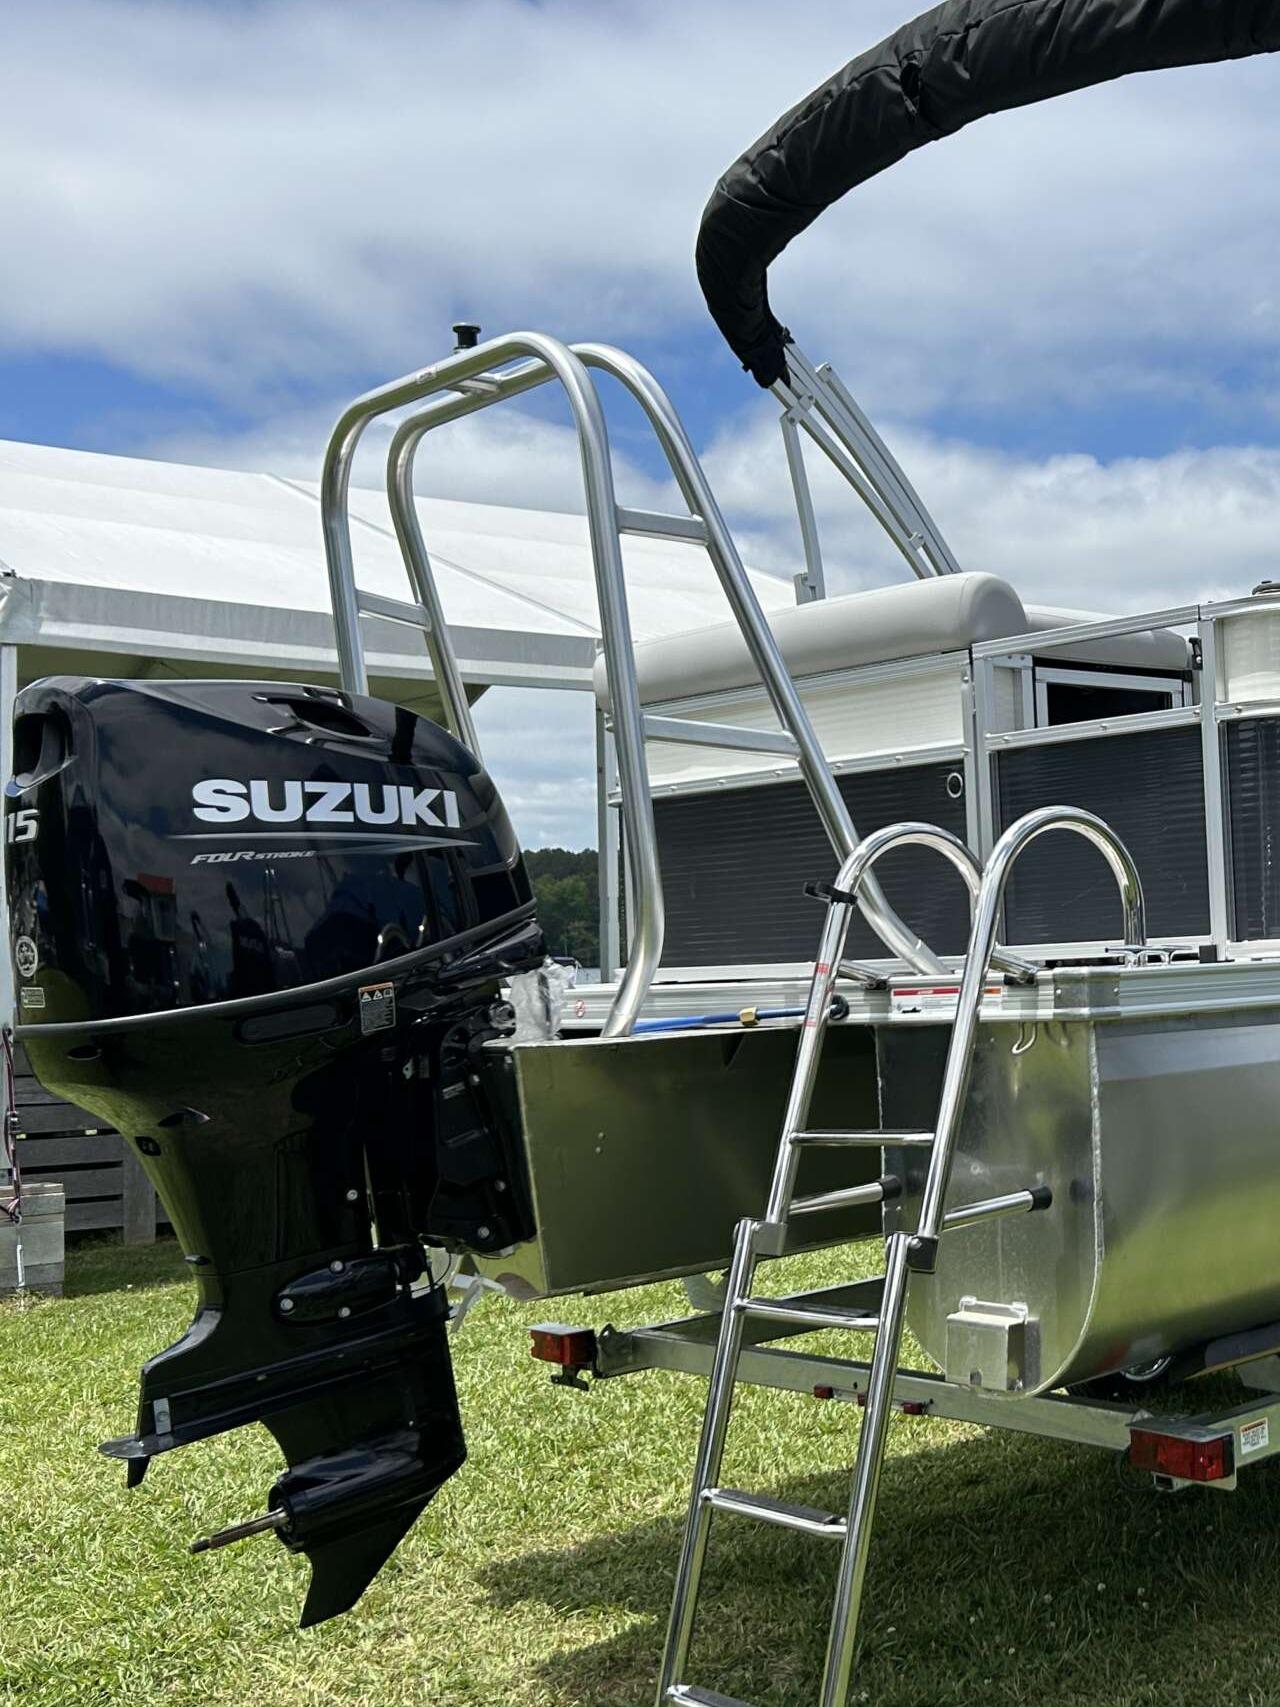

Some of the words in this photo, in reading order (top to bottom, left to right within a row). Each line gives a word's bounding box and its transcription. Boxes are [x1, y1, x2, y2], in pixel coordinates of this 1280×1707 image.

[192, 779, 461, 828] SUZUKI
[190, 851, 255, 865] FOUR
[254, 850, 317, 860] STROKE
